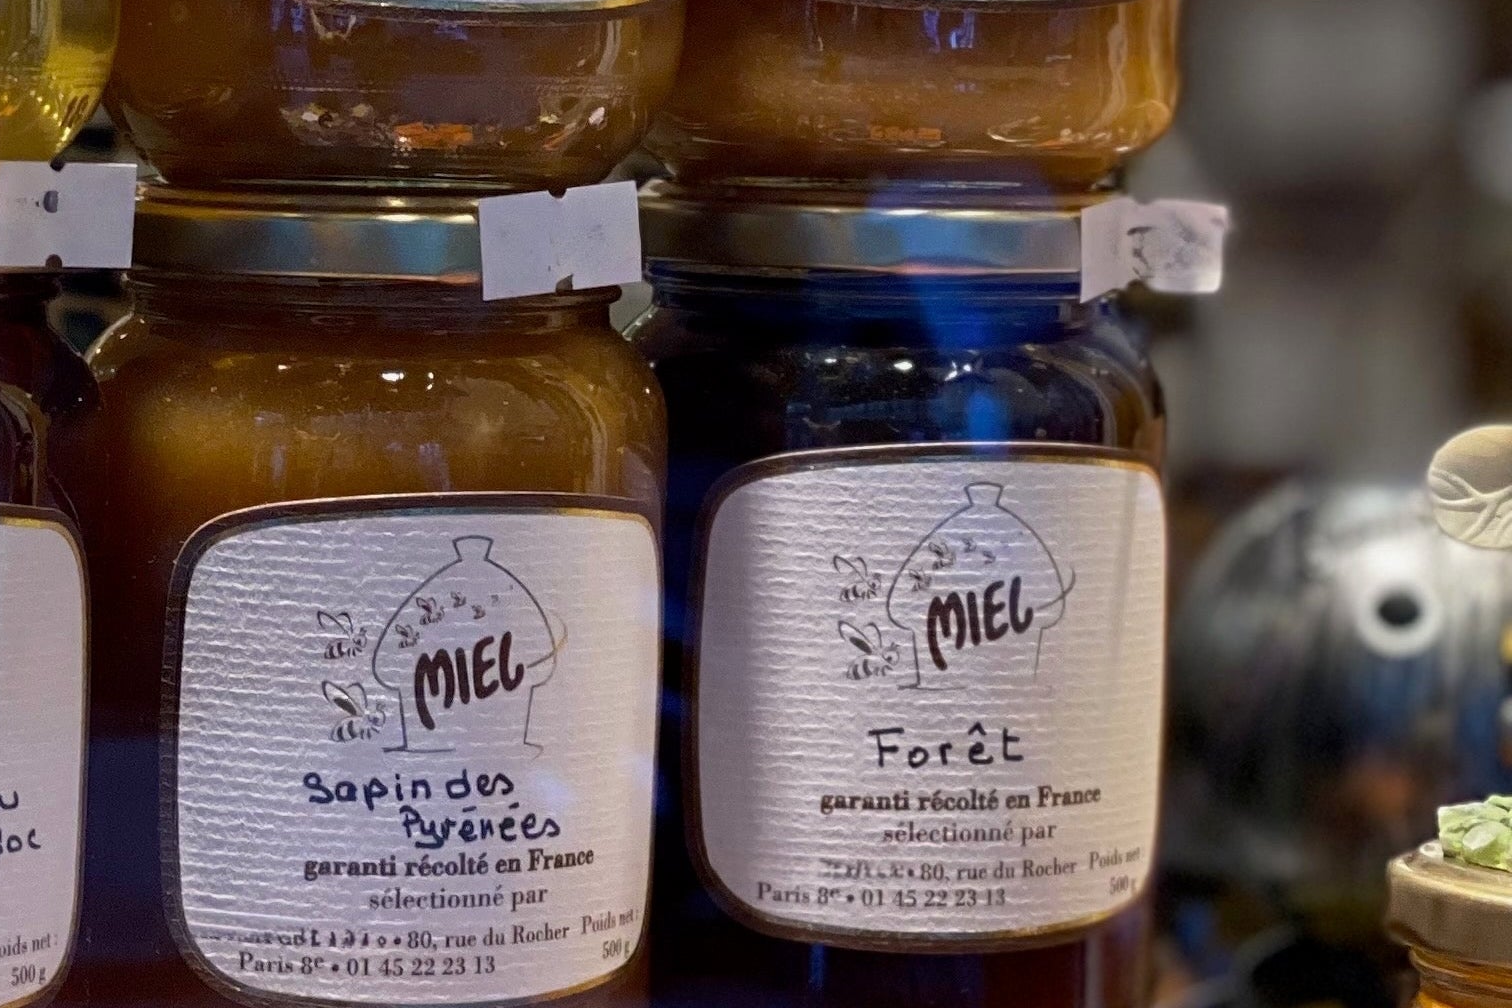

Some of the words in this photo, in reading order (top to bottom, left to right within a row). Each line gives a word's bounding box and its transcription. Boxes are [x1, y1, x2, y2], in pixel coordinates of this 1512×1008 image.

[927, 576, 1033, 671] MIEL
[415, 631, 524, 730] MIEL
[868, 722, 1023, 768] Forêt
[446, 769, 515, 799] des
[820, 789, 910, 814] garanti
[918, 789, 998, 811] récolté
[1005, 791, 1029, 809] en
[1036, 785, 1100, 806] France
[400, 803, 559, 849] Pyrénées
[883, 821, 1013, 842] sélectionné
[1021, 823, 1056, 844] par
[304, 857, 396, 880] garanti
[405, 853, 488, 876] récolté
[496, 856, 521, 874] en
[528, 848, 594, 871] France
[957, 865, 987, 880] rue
[994, 860, 1015, 878] du
[1022, 858, 1076, 878] Rocher
[369, 885, 503, 910] sélectionné
[511, 888, 548, 912] par
[862, 888, 884, 906] 01
[892, 888, 917, 907] 45
[924, 889, 947, 907] 22
[955, 888, 977, 906] 23
[445, 933, 476, 948] rue
[483, 927, 506, 946] du
[512, 925, 569, 944] Rocher
[11, 964, 36, 986] 500
[239, 951, 292, 972] Paris
[348, 957, 369, 975] 01
[379, 957, 403, 975] 45
[411, 958, 435, 975] 22
[442, 957, 466, 975] 23
[475, 955, 495, 974] 13
